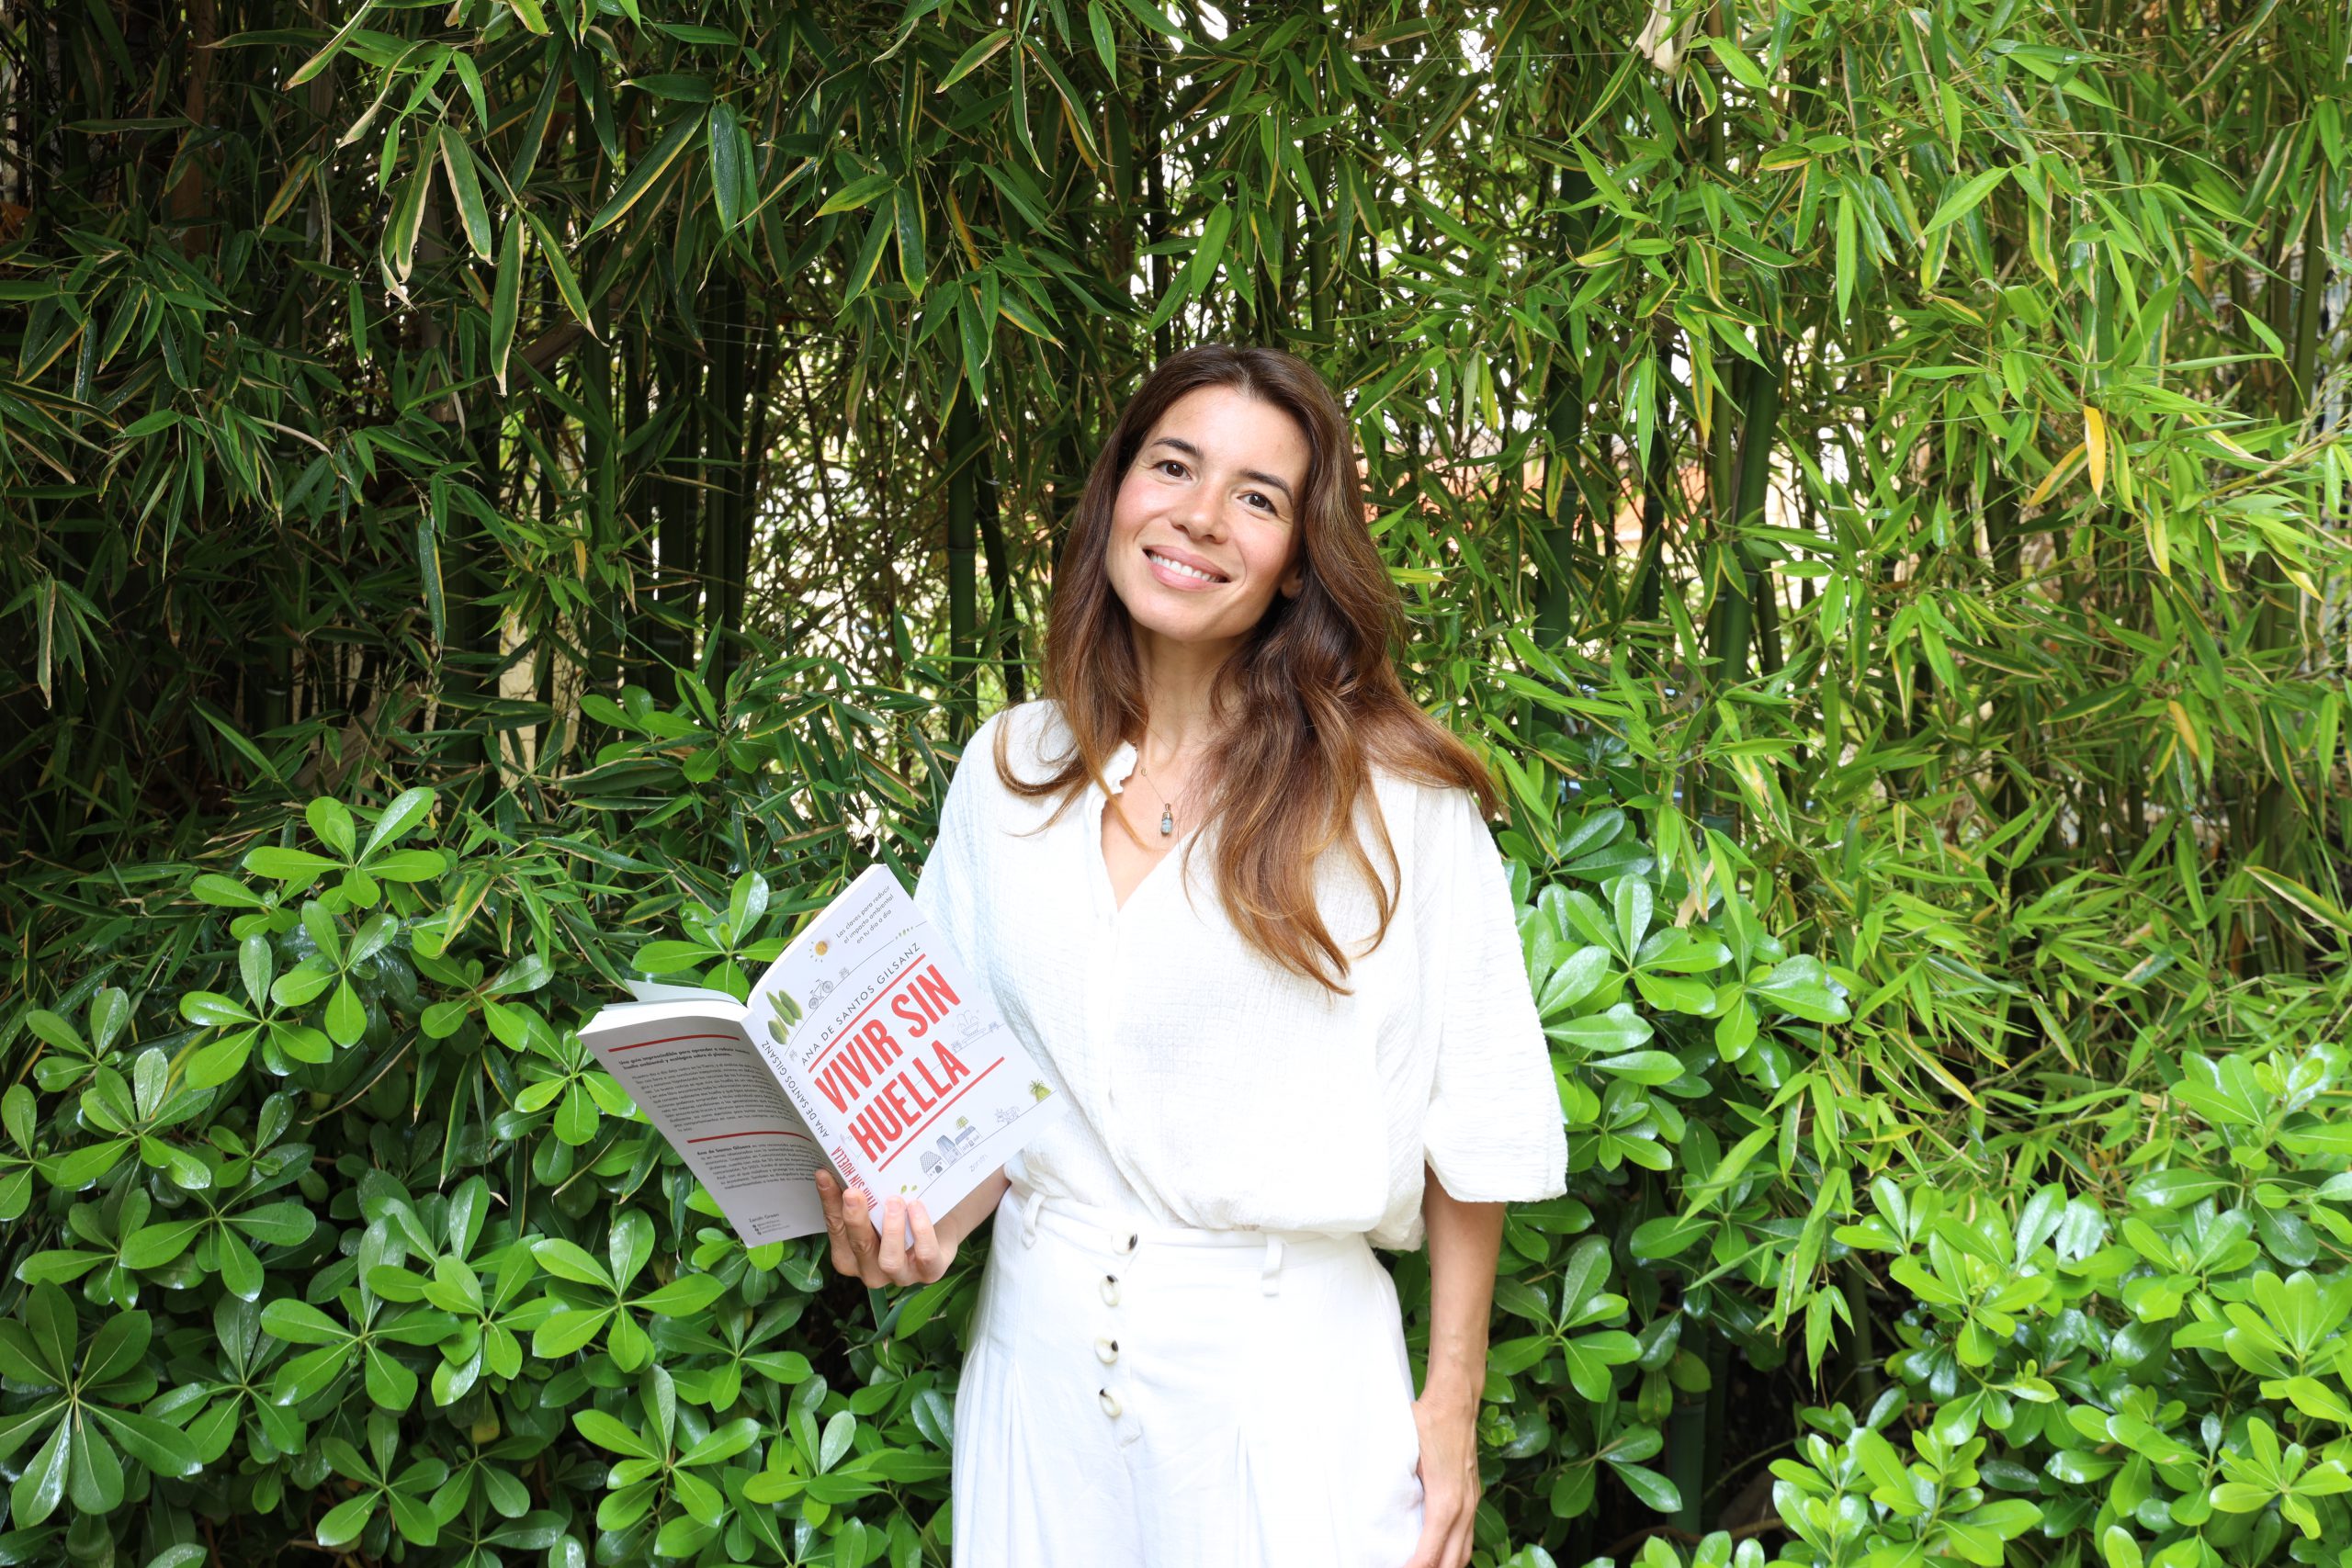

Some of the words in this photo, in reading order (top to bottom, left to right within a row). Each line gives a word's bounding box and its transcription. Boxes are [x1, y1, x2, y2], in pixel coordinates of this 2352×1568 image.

[836, 929, 846, 939] Las
[845, 914, 861, 930] claves
[861, 903, 873, 916] para
[873, 886, 890, 903] reducir
[850, 919, 869, 938] impacto
[869, 894, 894, 919] ambiental
[856, 936, 865, 944] en
[801, 1043, 820, 1066] ANA
[820, 1025, 835, 1042] DE
[835, 985, 875, 1026] SANTOS
[876, 942, 921, 985] GILSANZ
[814, 1019, 904, 1114] VIVIR
[891, 964, 961, 1038] SIN
[762, 1040, 787, 1076] GILSANZ
[785, 1076, 808, 1109] SANTOS
[847, 1039, 971, 1164] HUELLA
[806, 1108, 818, 1121] DE
[815, 1120, 830, 1138] ANA
[831, 1145, 856, 1178] HUELLA
